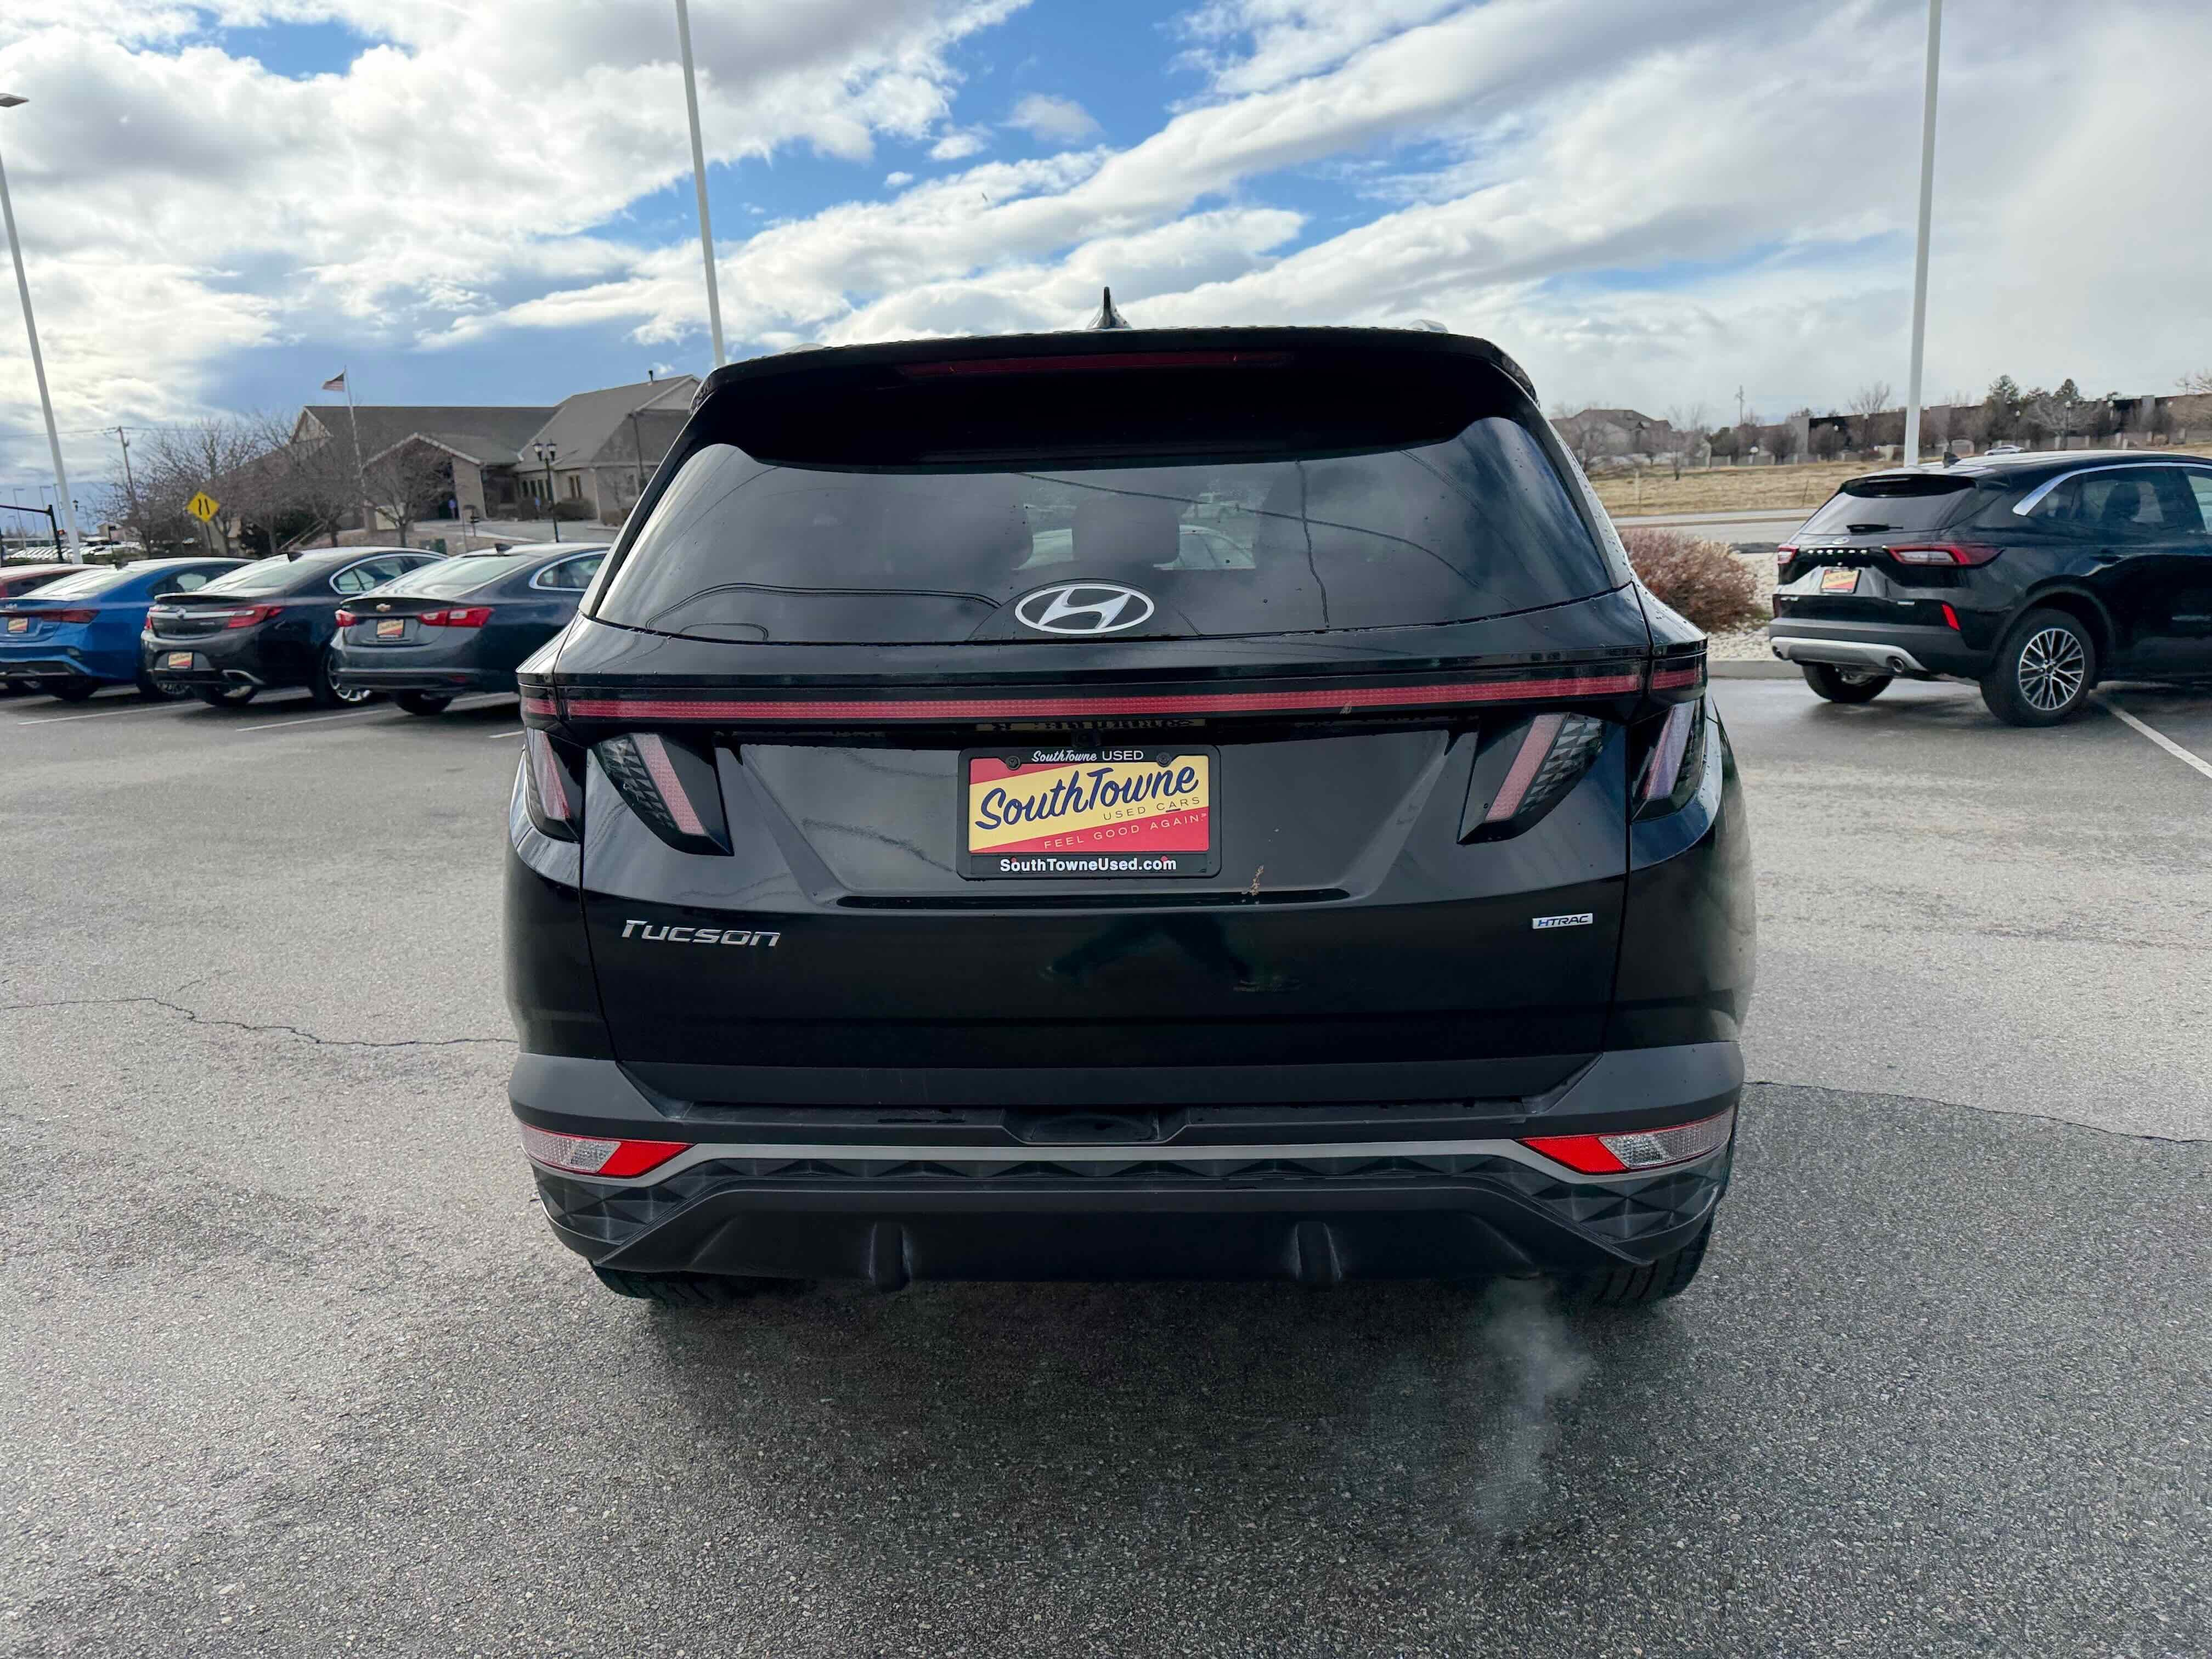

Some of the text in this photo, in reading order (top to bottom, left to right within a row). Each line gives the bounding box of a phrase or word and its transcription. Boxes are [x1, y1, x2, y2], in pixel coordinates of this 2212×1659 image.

[1031, 750, 1144, 762] SouthTowne USED
[975, 766, 1199, 830] SouthTowne
[1103, 797, 1200, 821] USED CARS
[1044, 836, 1085, 849] FEEL
[1093, 825, 1139, 840] GOOD
[1000, 858, 1176, 872] SouthTowneUsed.com
[1538, 915, 1589, 927] HTRAC
